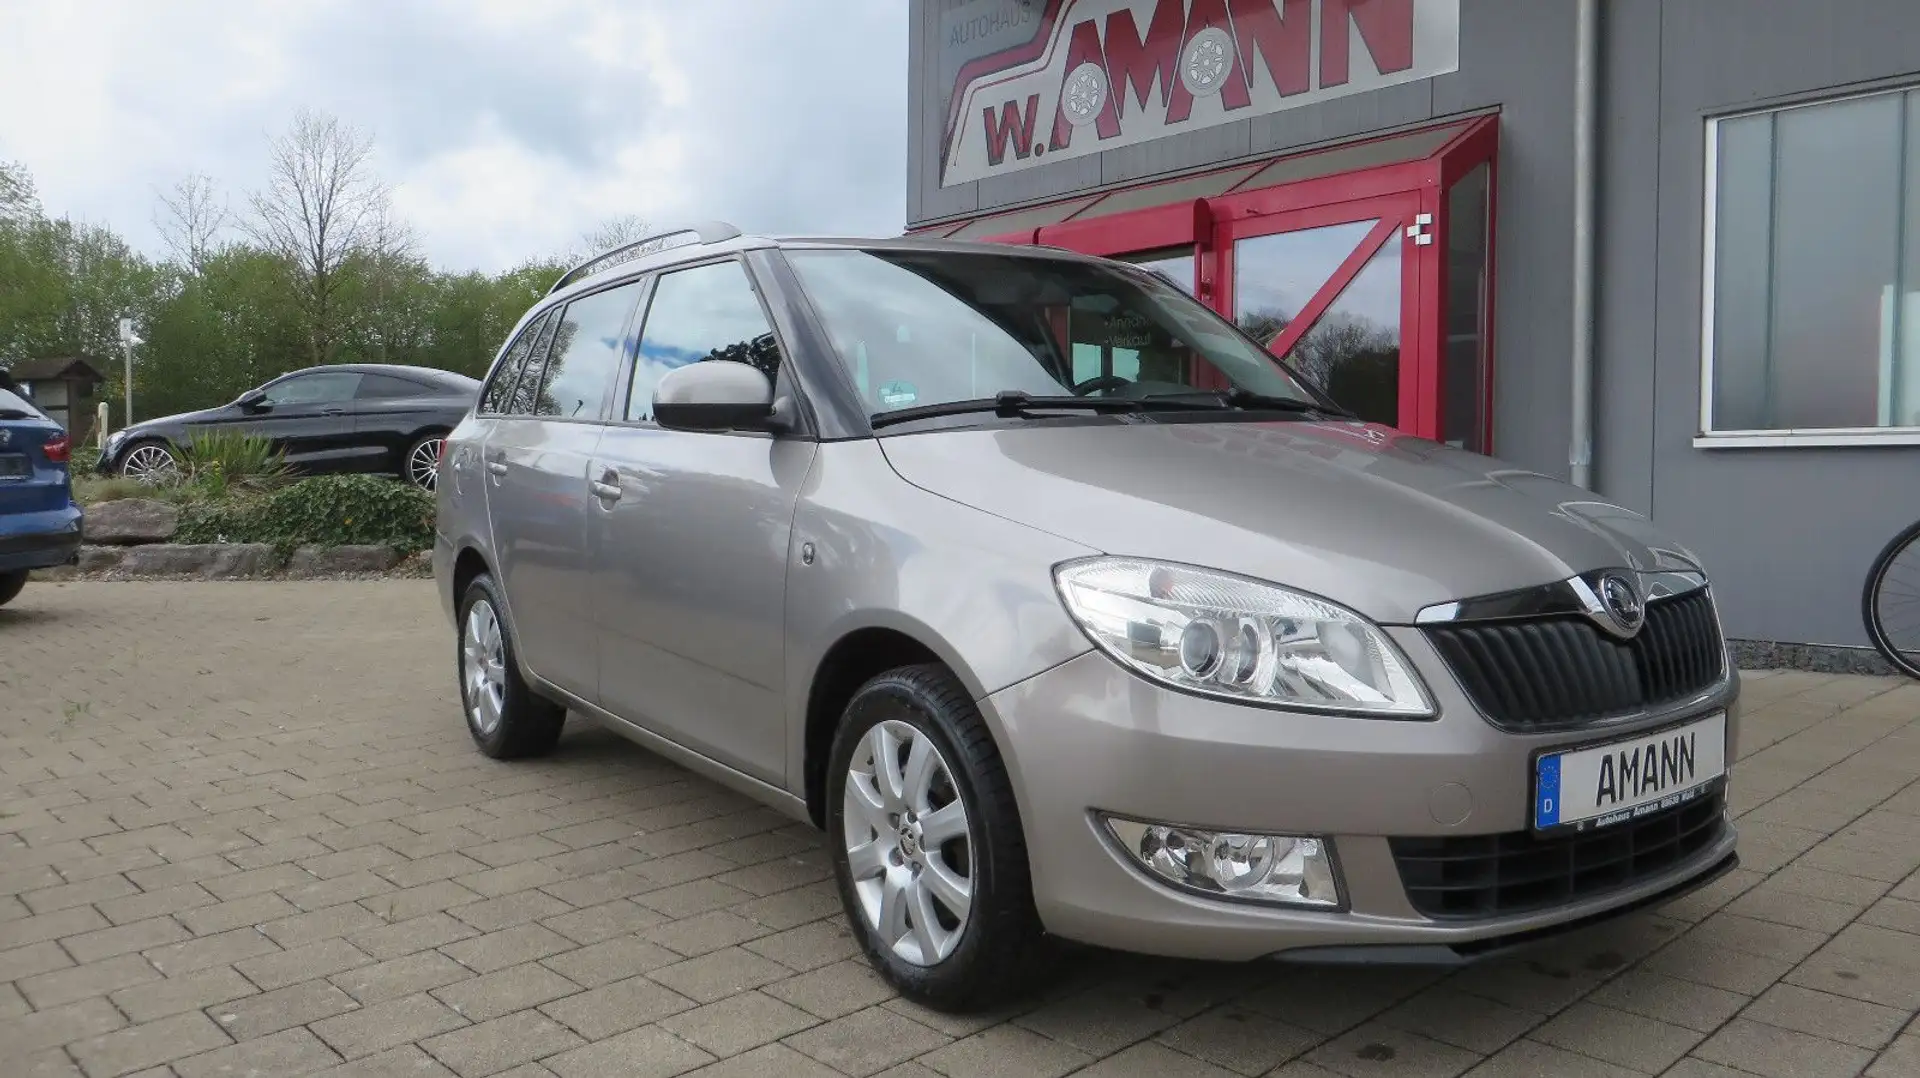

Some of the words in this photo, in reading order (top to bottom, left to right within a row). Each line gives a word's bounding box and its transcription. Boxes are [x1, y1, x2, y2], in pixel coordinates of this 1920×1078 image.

[948, 5, 1031, 48] AUTOHAUS
[1596, 731, 1696, 808] AMANN
[1543, 798, 1553, 813] D
